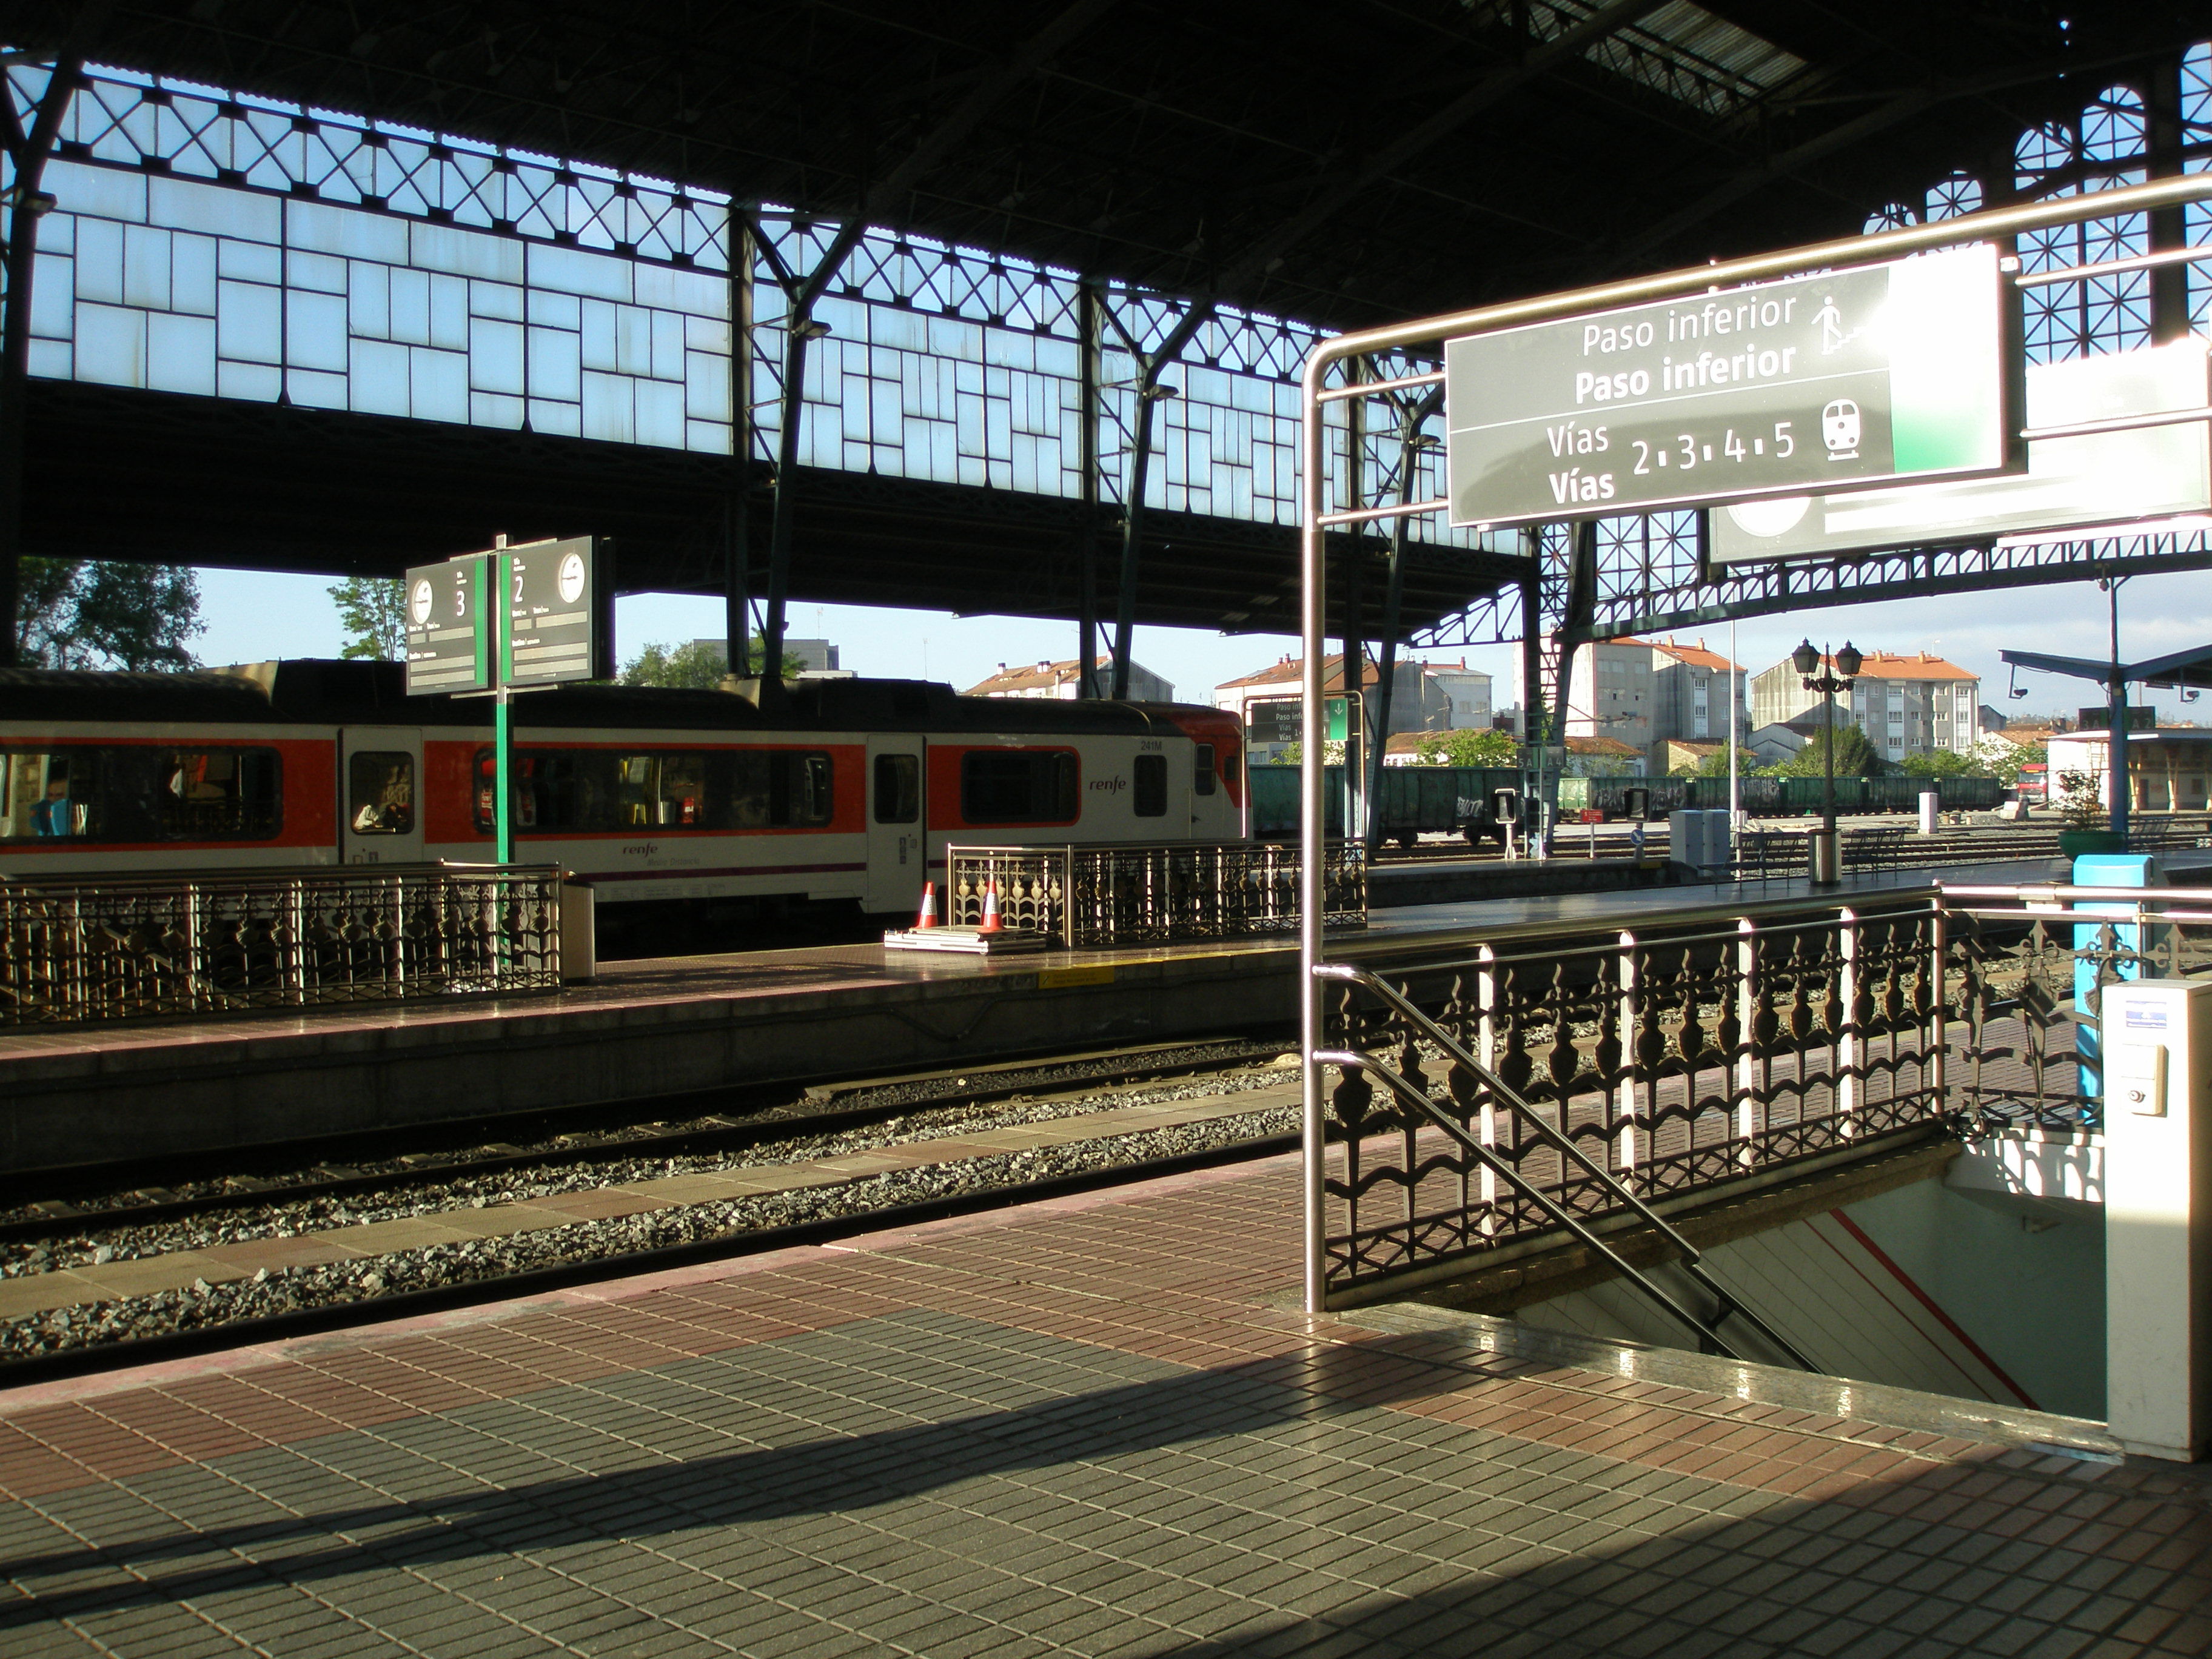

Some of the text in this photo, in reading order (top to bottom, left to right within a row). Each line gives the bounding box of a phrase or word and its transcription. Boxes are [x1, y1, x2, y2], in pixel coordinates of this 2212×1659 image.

[1583, 295, 1797, 357] Paso inferior
[1576, 343, 1797, 404] Paso inferior
[1547, 421, 1609, 458] Vías
[1549, 467, 1615, 504] Vías
[515, 575, 524, 603] 2
[457, 590, 465, 617] 3
[1141, 740, 1162, 751] 241M
[1518, 758, 1532, 768] 5 A
[1547, 757, 1552, 766] A
[1090, 775, 1126, 795] renfe
[622, 842, 658, 857] renfe
